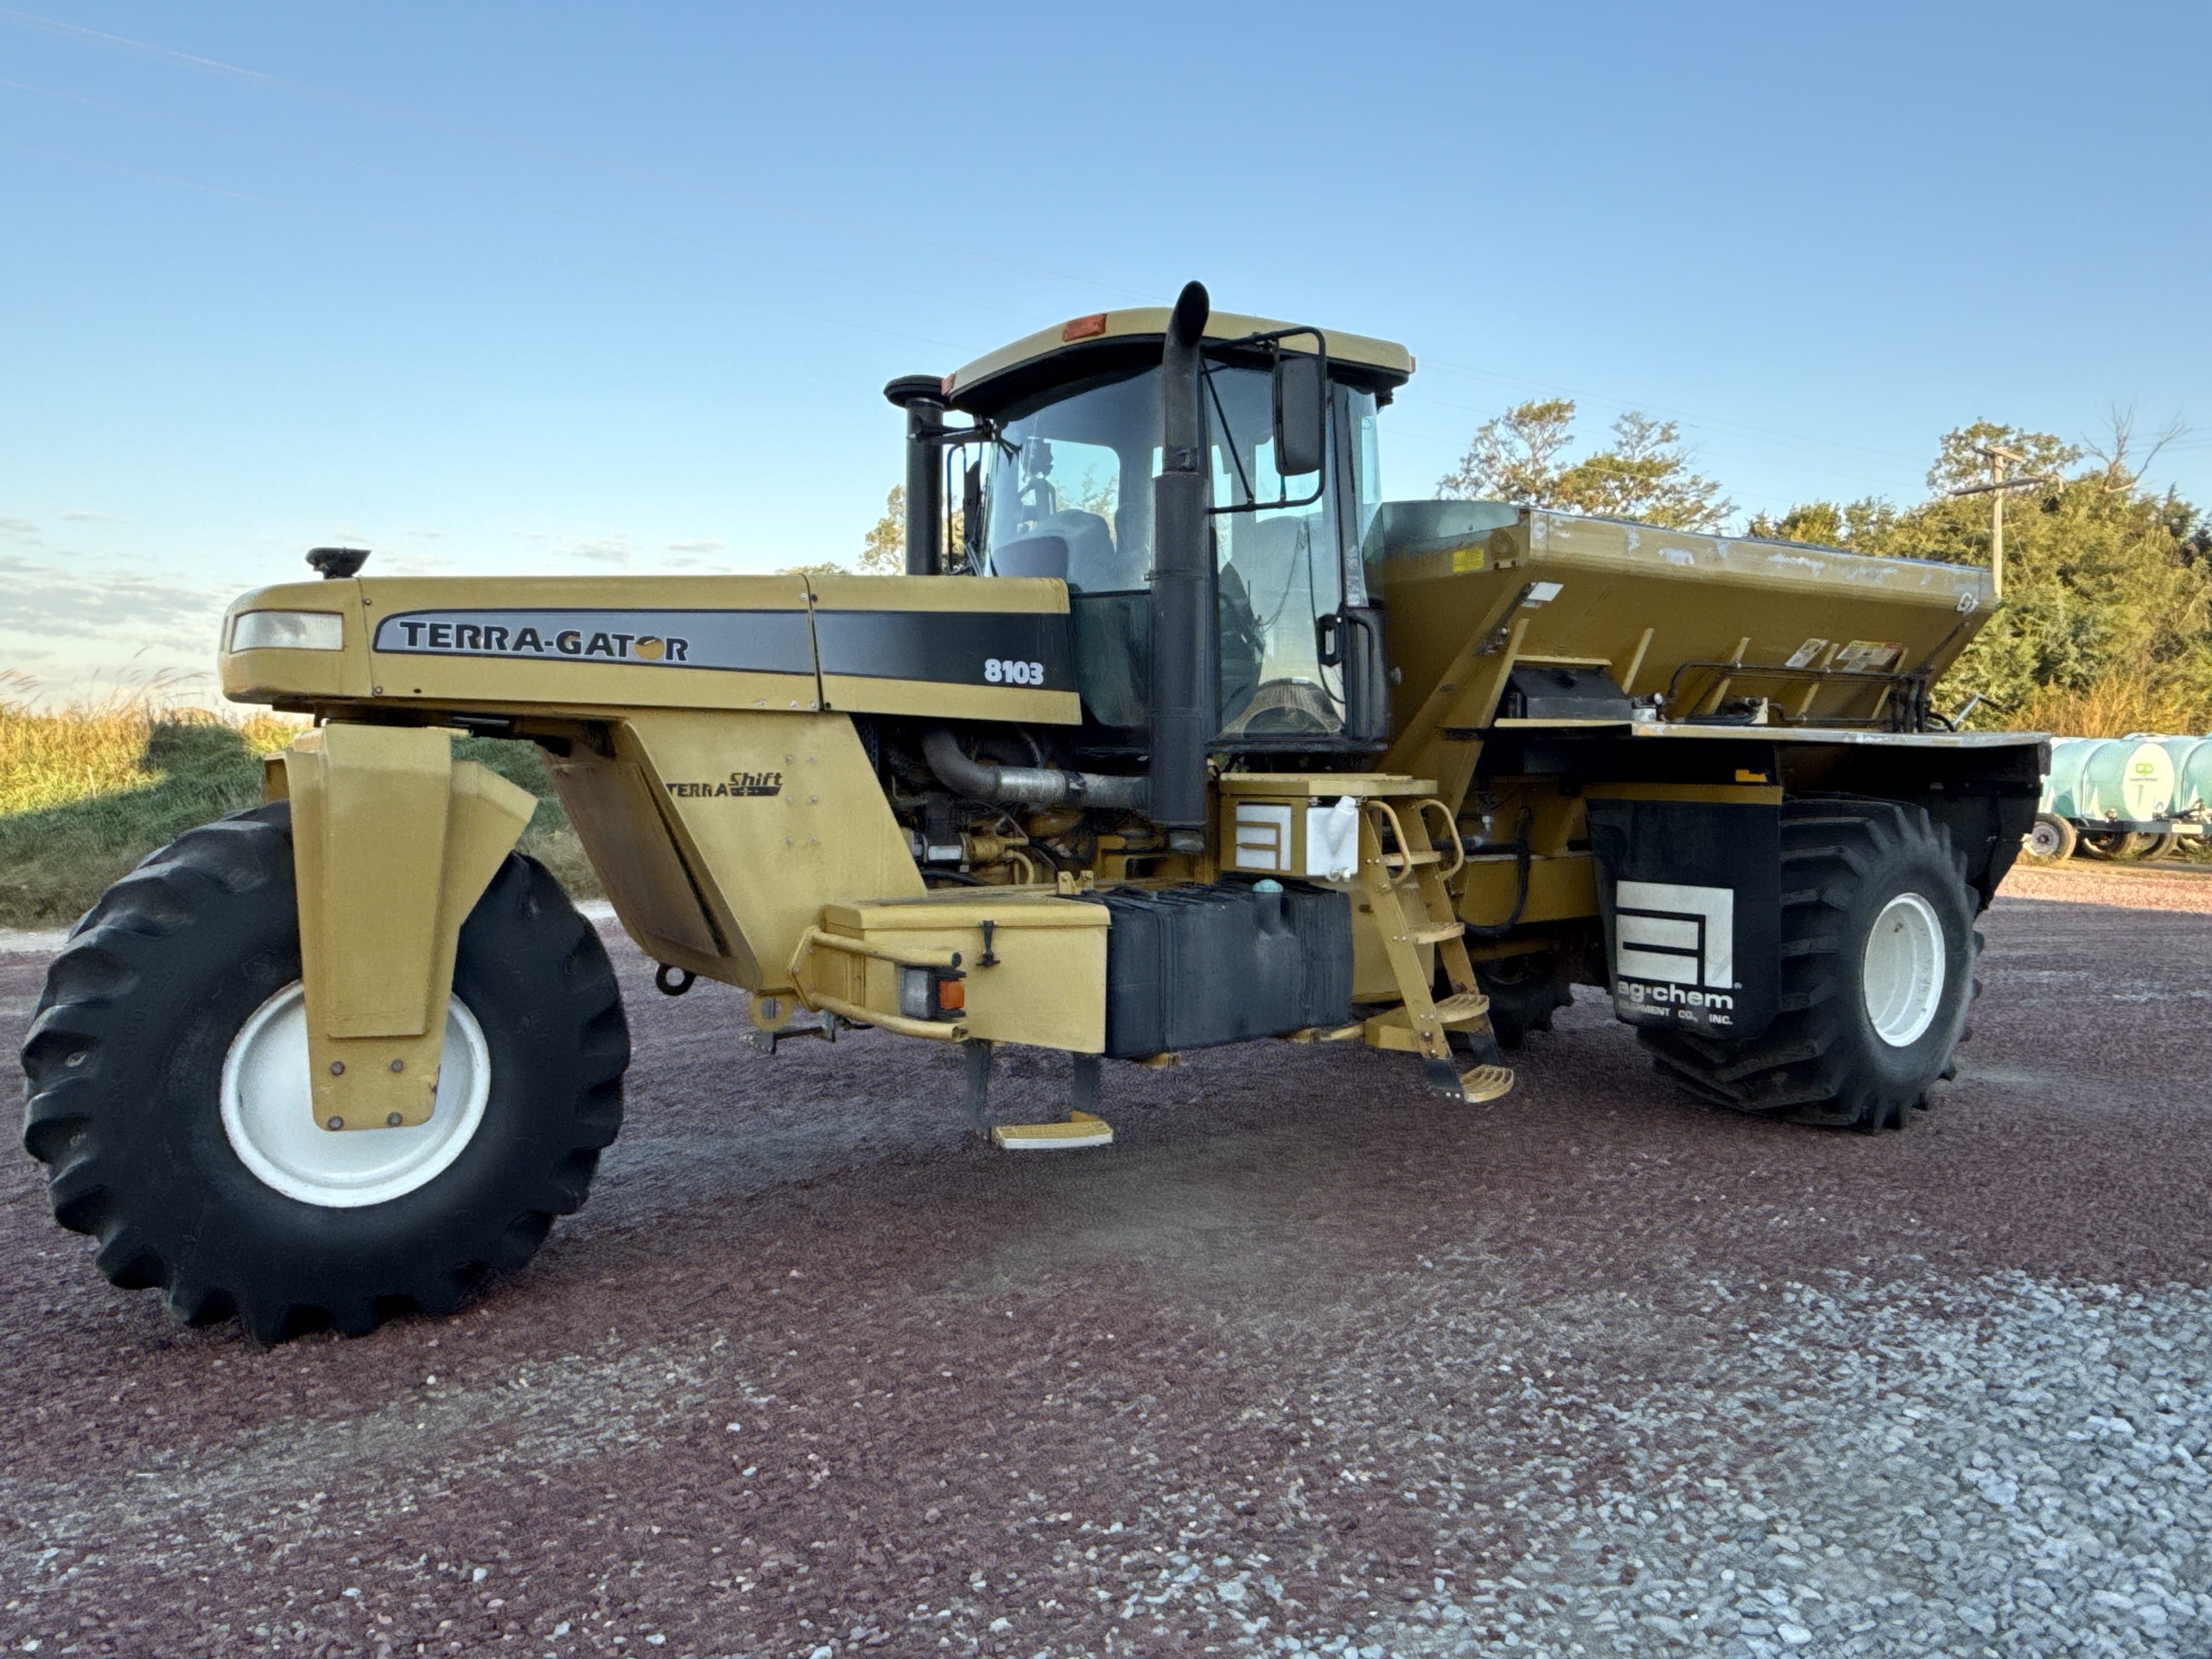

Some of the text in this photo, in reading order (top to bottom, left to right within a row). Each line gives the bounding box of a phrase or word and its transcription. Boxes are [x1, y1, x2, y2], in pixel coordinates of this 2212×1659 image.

[399, 621, 689, 662] TERRA-GATOR
[984, 658, 1043, 685] 8103
[728, 772, 784, 786] Shift
[1709, 1014, 1733, 1025] INC.
